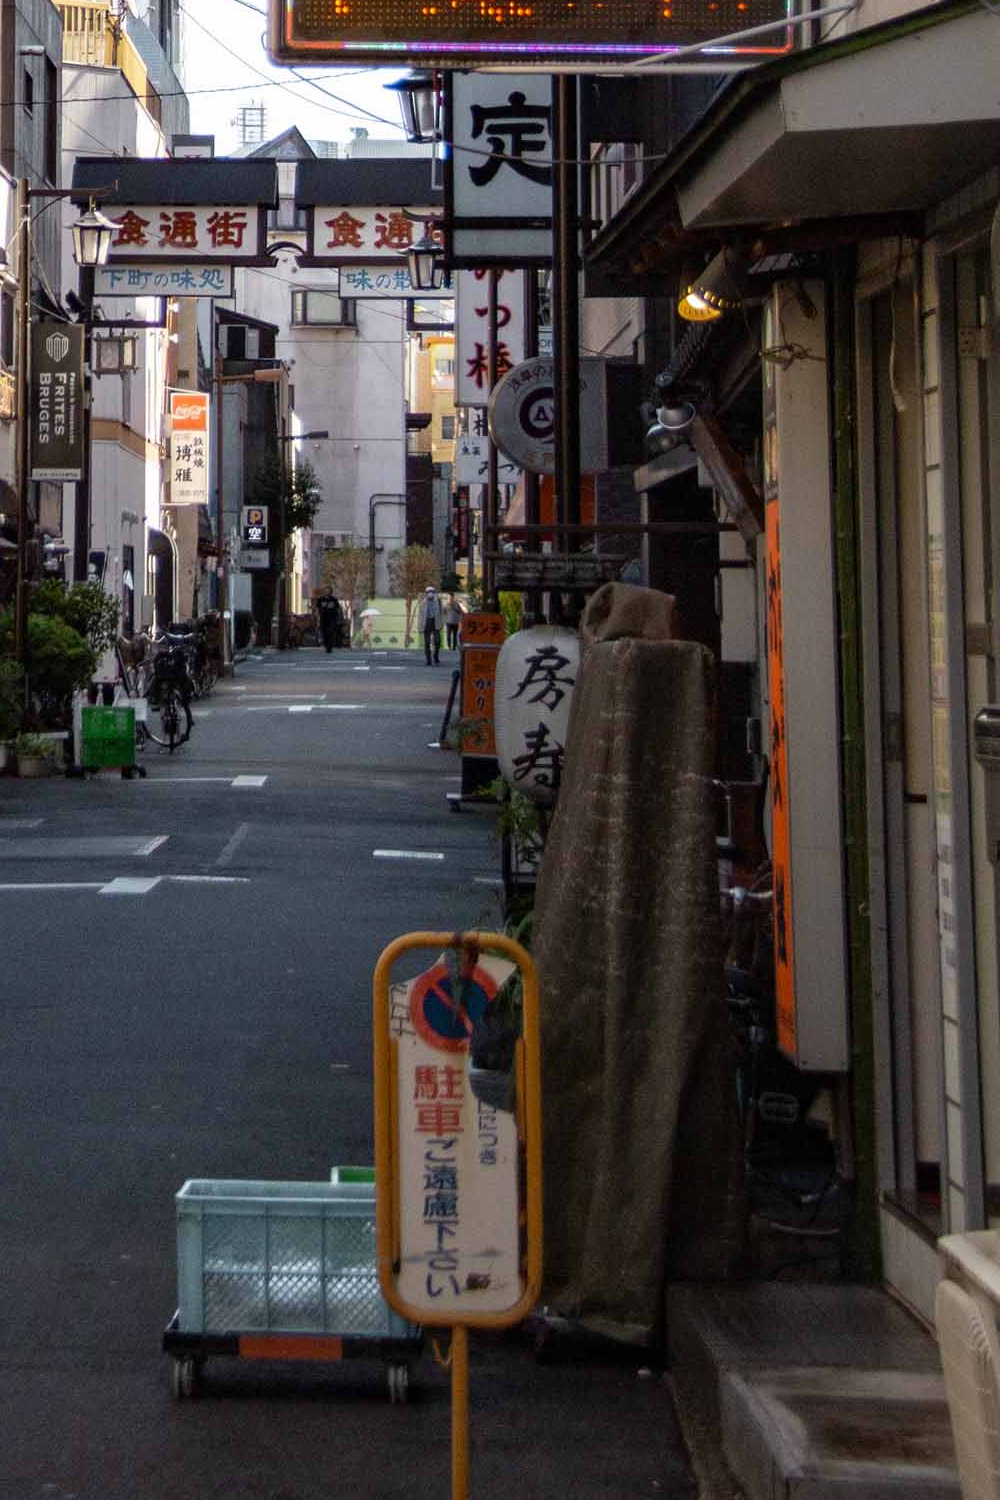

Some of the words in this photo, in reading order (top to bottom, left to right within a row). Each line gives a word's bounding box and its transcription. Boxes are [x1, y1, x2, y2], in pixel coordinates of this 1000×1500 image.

[111, 210, 248, 249] 食通街
[324, 211, 444, 250] 食通
[101, 267, 225, 290] 下町の味処
[466, 268, 514, 389] つ橋
[39, 372, 52, 445] BRUGES
[54, 372, 67, 436] FRITES
[248, 527, 266, 541] 空
